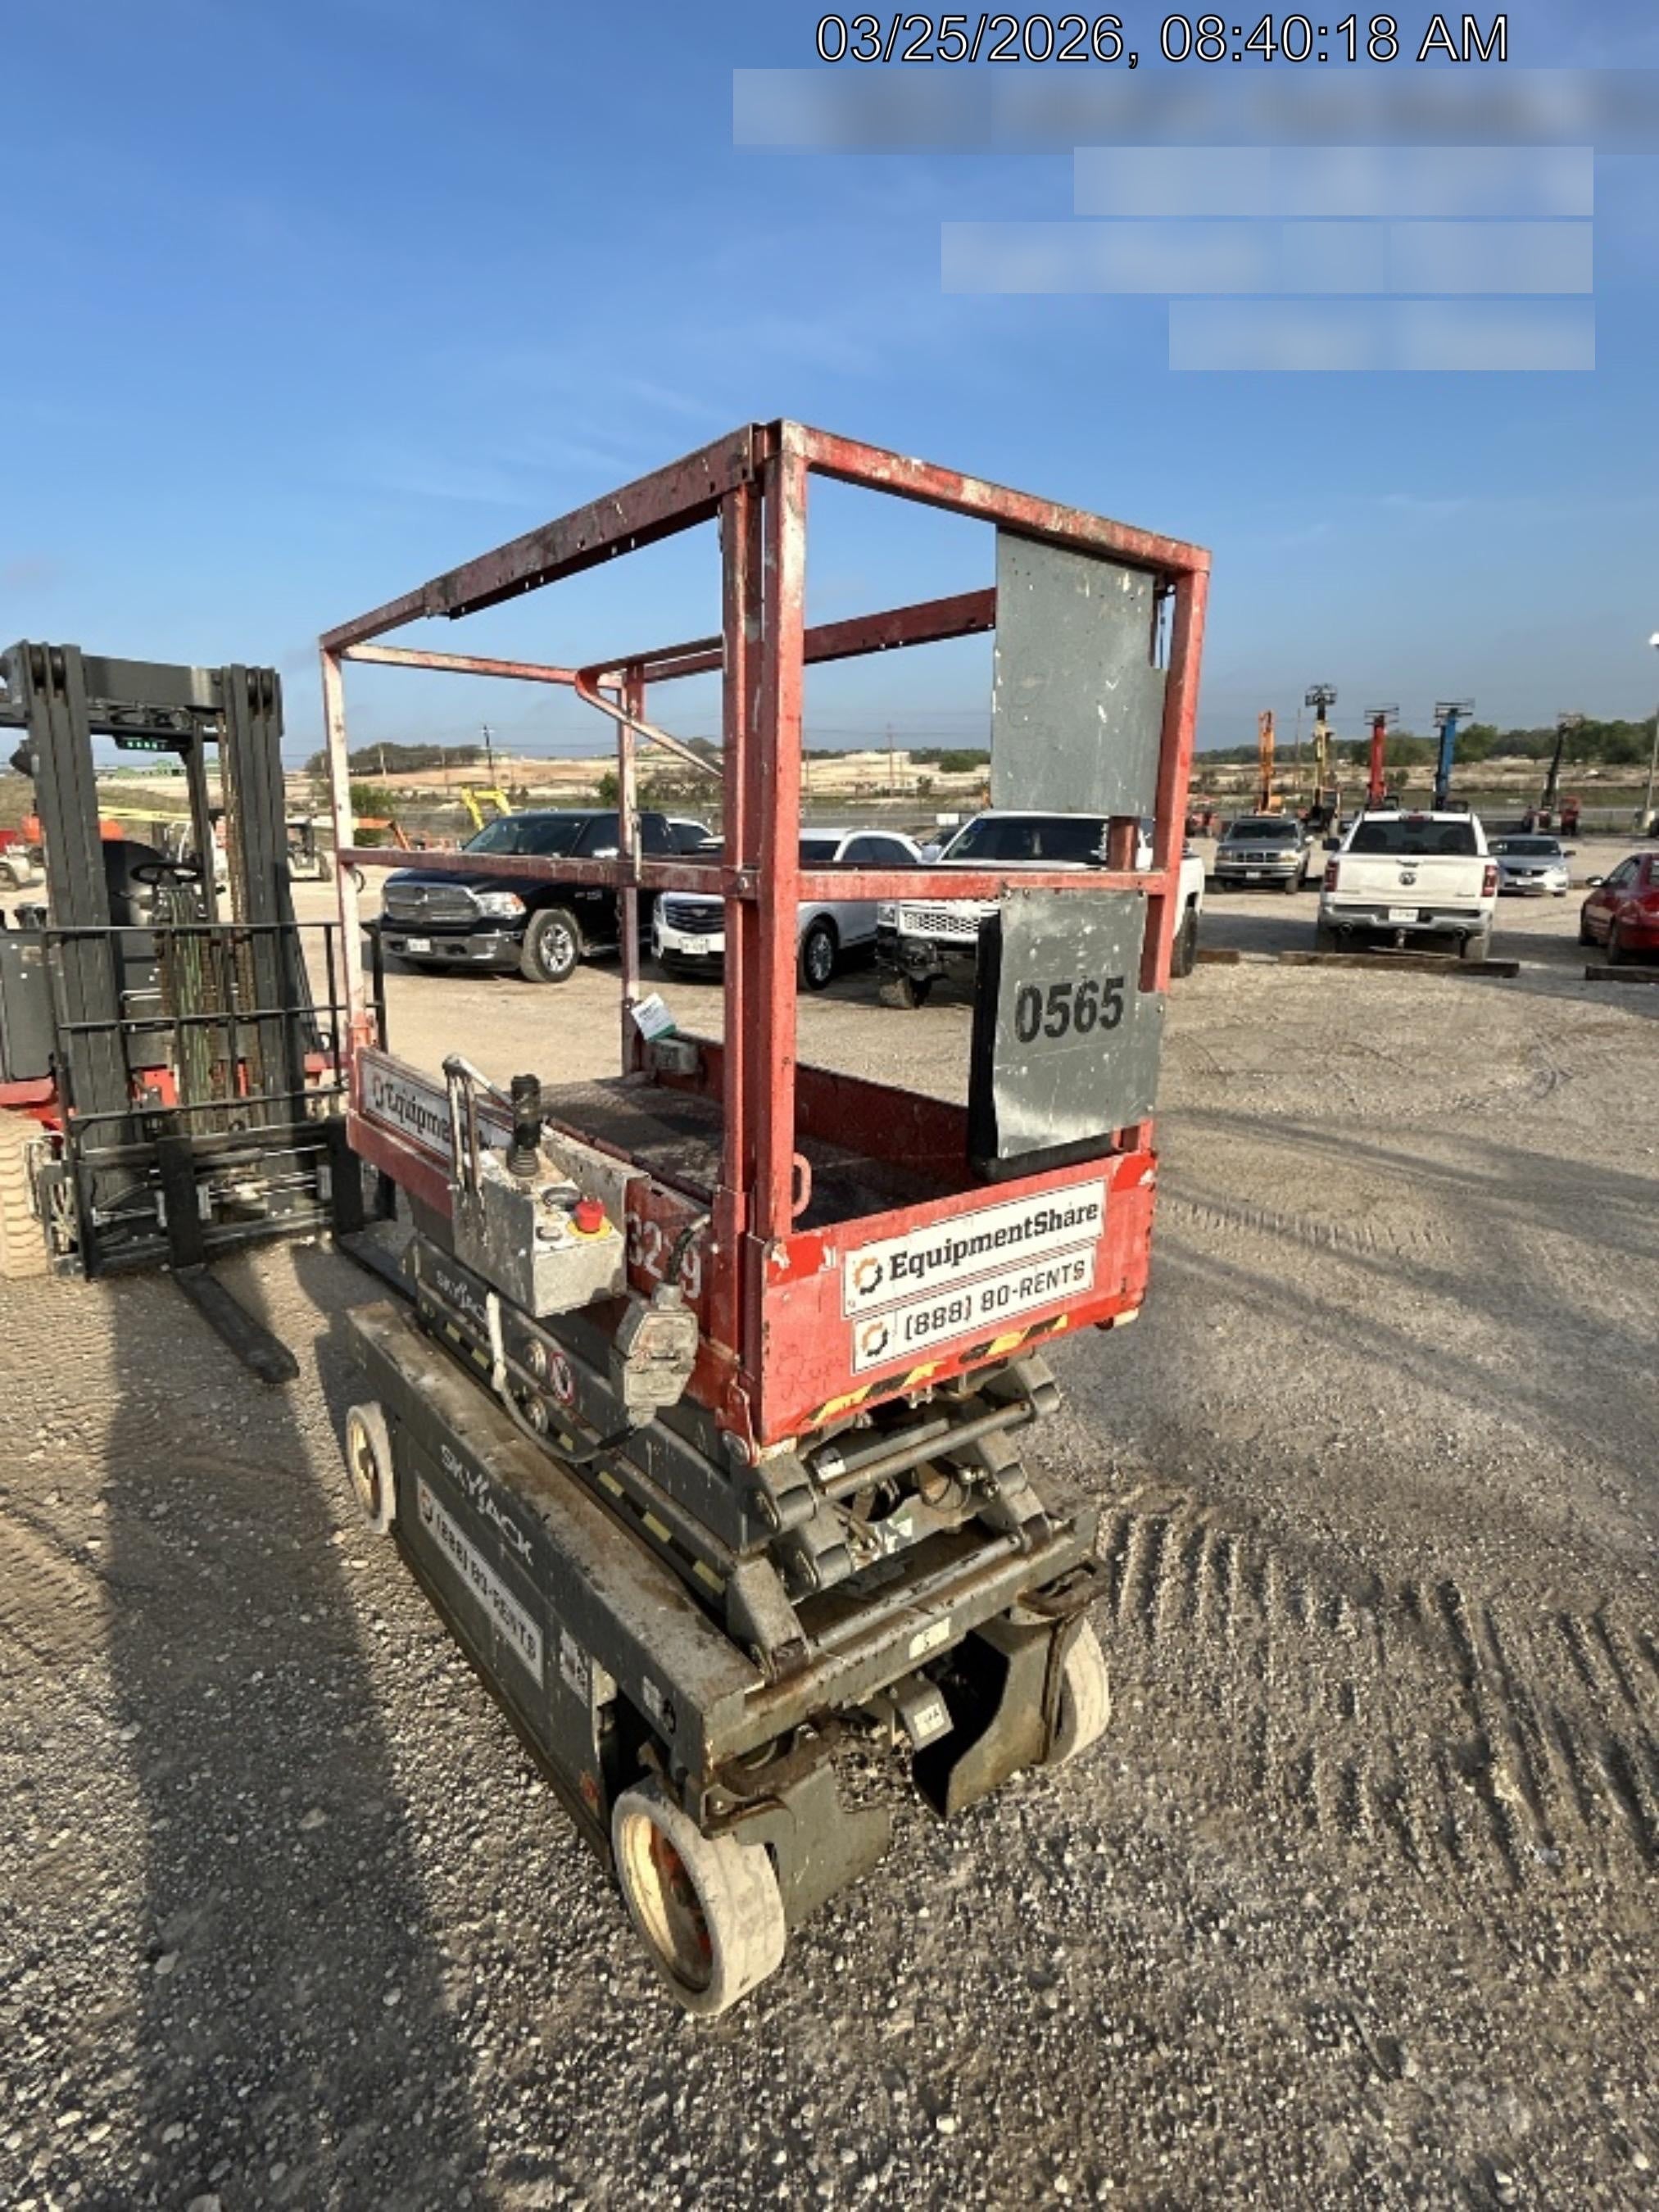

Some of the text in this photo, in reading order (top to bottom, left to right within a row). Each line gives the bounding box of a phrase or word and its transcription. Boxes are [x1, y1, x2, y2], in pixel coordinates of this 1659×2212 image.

[1015, 976, 1125, 1043] 0565
[889, 1203, 1099, 1281] EquipmentShare
[905, 1260, 1086, 1341] (888) 80-RENTS
